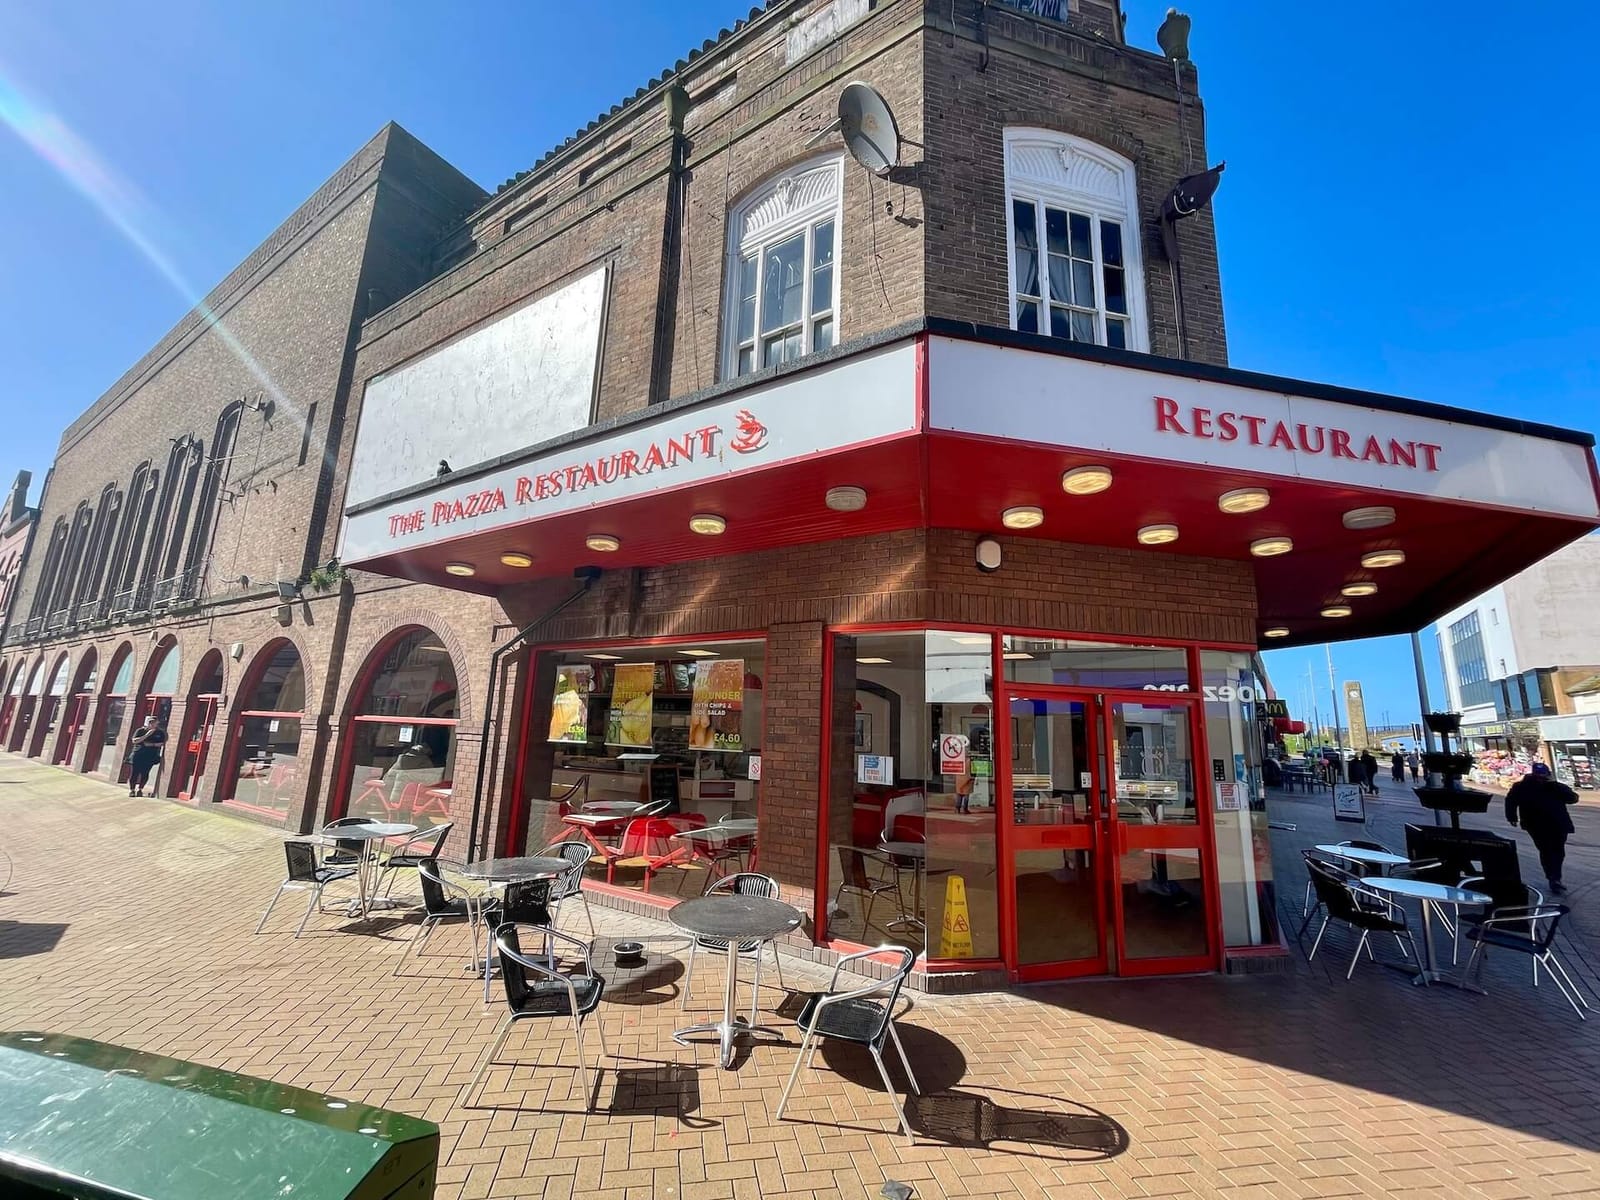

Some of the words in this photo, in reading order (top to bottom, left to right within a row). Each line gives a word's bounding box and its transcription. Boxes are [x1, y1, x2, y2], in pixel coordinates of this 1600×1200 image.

[1153, 395, 1442, 472] RESTAURANT
[388, 507, 426, 538] THE
[431, 486, 508, 527] PIAZZA
[515, 424, 724, 505] RESTAURANT
[713, 732, 740, 743] £4.60
